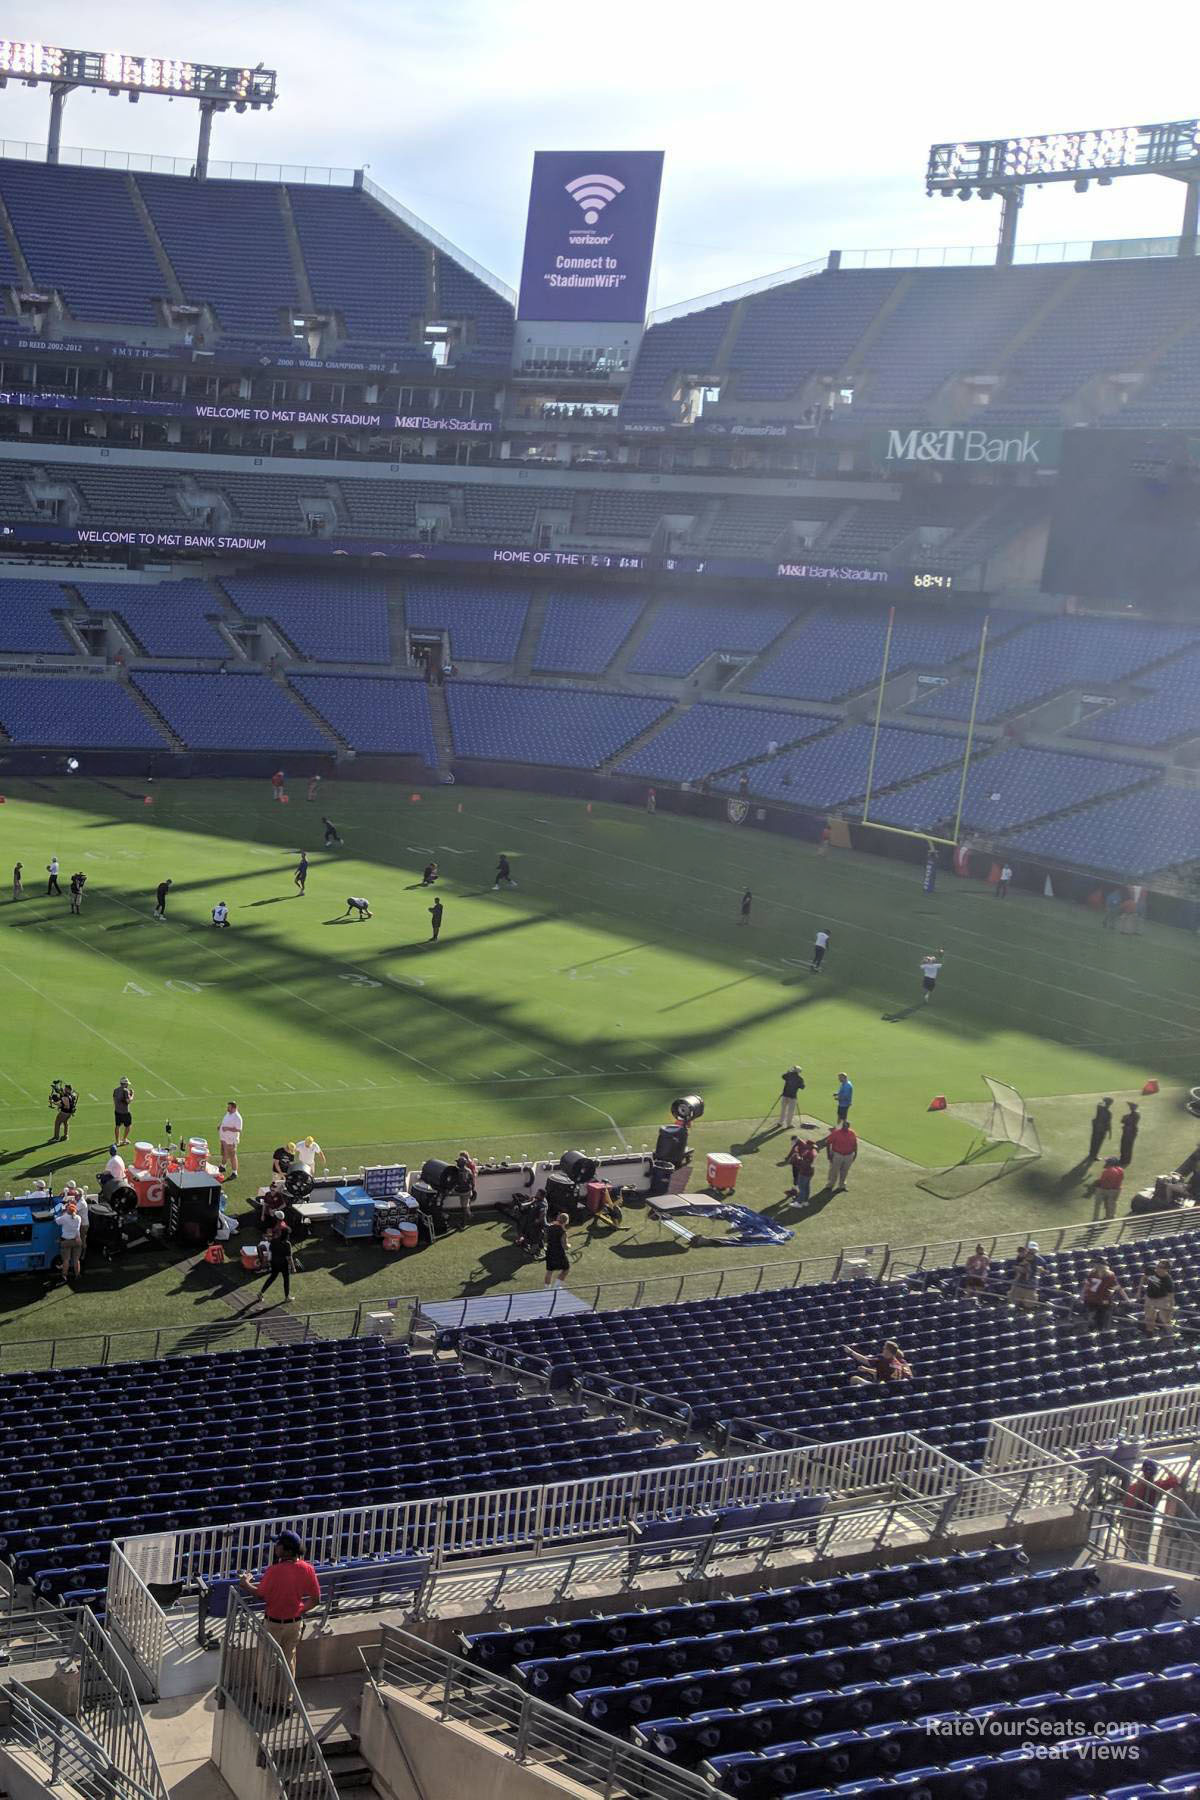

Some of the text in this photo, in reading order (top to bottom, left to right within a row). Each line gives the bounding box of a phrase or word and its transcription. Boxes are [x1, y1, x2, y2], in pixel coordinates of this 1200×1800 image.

[569, 234, 608, 245] verizon
[556, 255, 617, 269] Connect to
[29, 341, 46, 349] REED
[299, 360, 323, 368] WORLD
[325, 361, 364, 370] CHAMPIONS
[196, 405, 380, 426] WELCOME TO M&T BANK STADIUM
[395, 416, 492, 432] M&T Bank Stadium
[885, 430, 1040, 463] M&T Bank
[77, 529, 266, 550] WELCOME TO M&T BANK STADIUM
[493, 550, 530, 563] HOME
[533, 552, 552, 564] OF
[555, 553, 579, 566] THE
[808, 566, 839, 579] Bank
[840, 567, 888, 582] Stadium
[708, 1163, 717, 1178] G
[147, 1184, 162, 1203] G
[1089, 1278, 1102, 1293] 7
